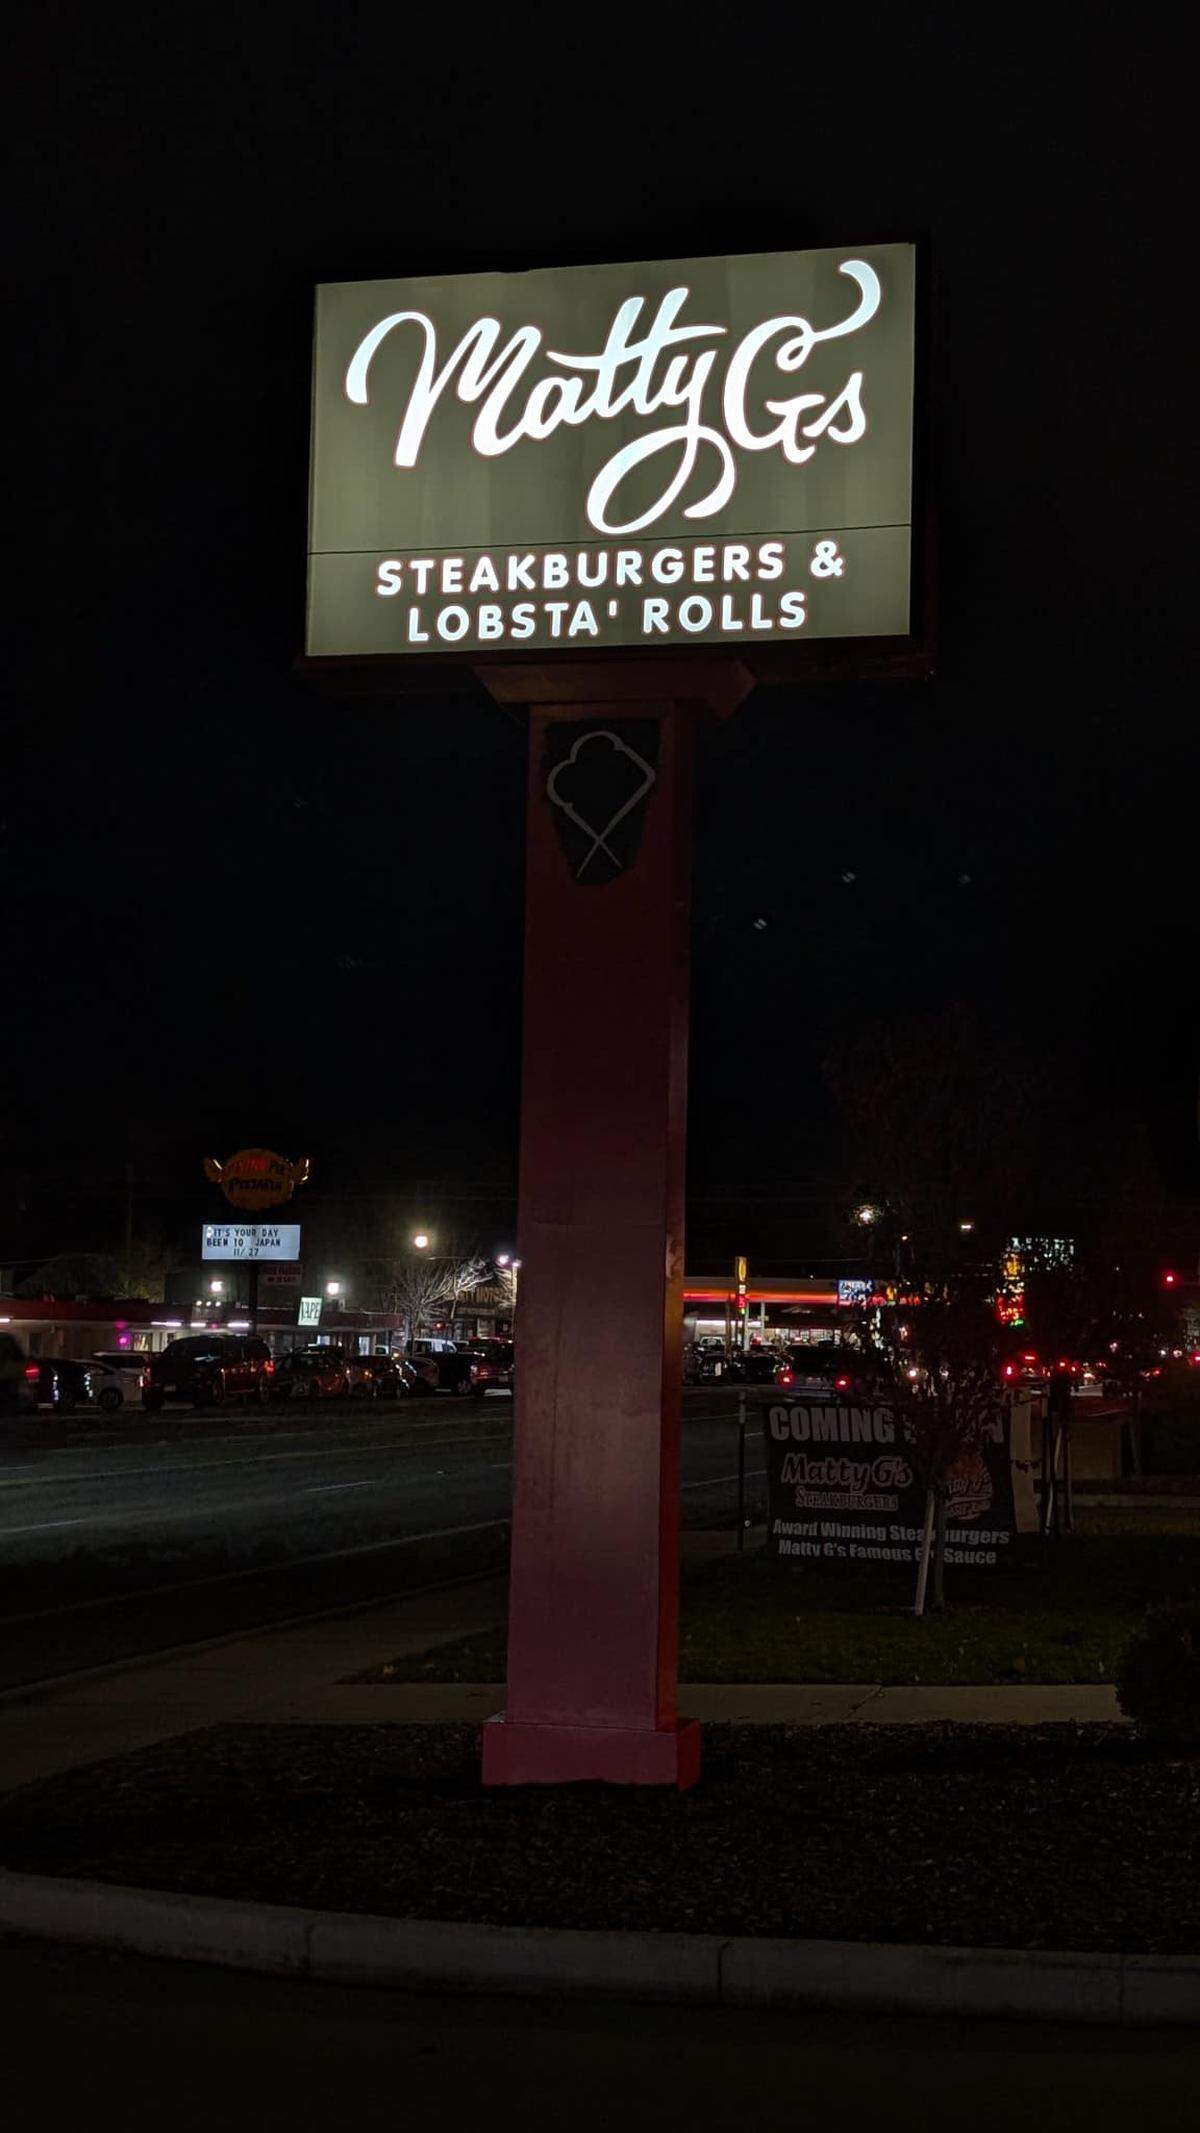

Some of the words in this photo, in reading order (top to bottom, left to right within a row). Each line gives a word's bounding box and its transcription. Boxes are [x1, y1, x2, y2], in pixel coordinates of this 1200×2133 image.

[345, 287, 736, 534] Matty
[377, 543, 785, 597] STEAKBURGERS
[810, 540, 846, 578] &
[407, 600, 619, 643] LOBSTA'
[643, 592, 806, 633] ROLLS
[234, 1238, 244, 1247] TO
[255, 1238, 281, 1247] JAPAN
[235, 1229, 257, 1237] YOUR
[262, 1229, 279, 1237] DAY
[768, 1406, 896, 1443] COMING
[782, 1453, 870, 1493] Matty
[772, 1519, 817, 1537] Award
[821, 1521, 887, 1542] Winning
[889, 1524, 1010, 1546] Steaurgers
[778, 1539, 822, 1558] Matty
[849, 1545, 912, 1562] Famous
[943, 1547, 998, 1565] Sauce
